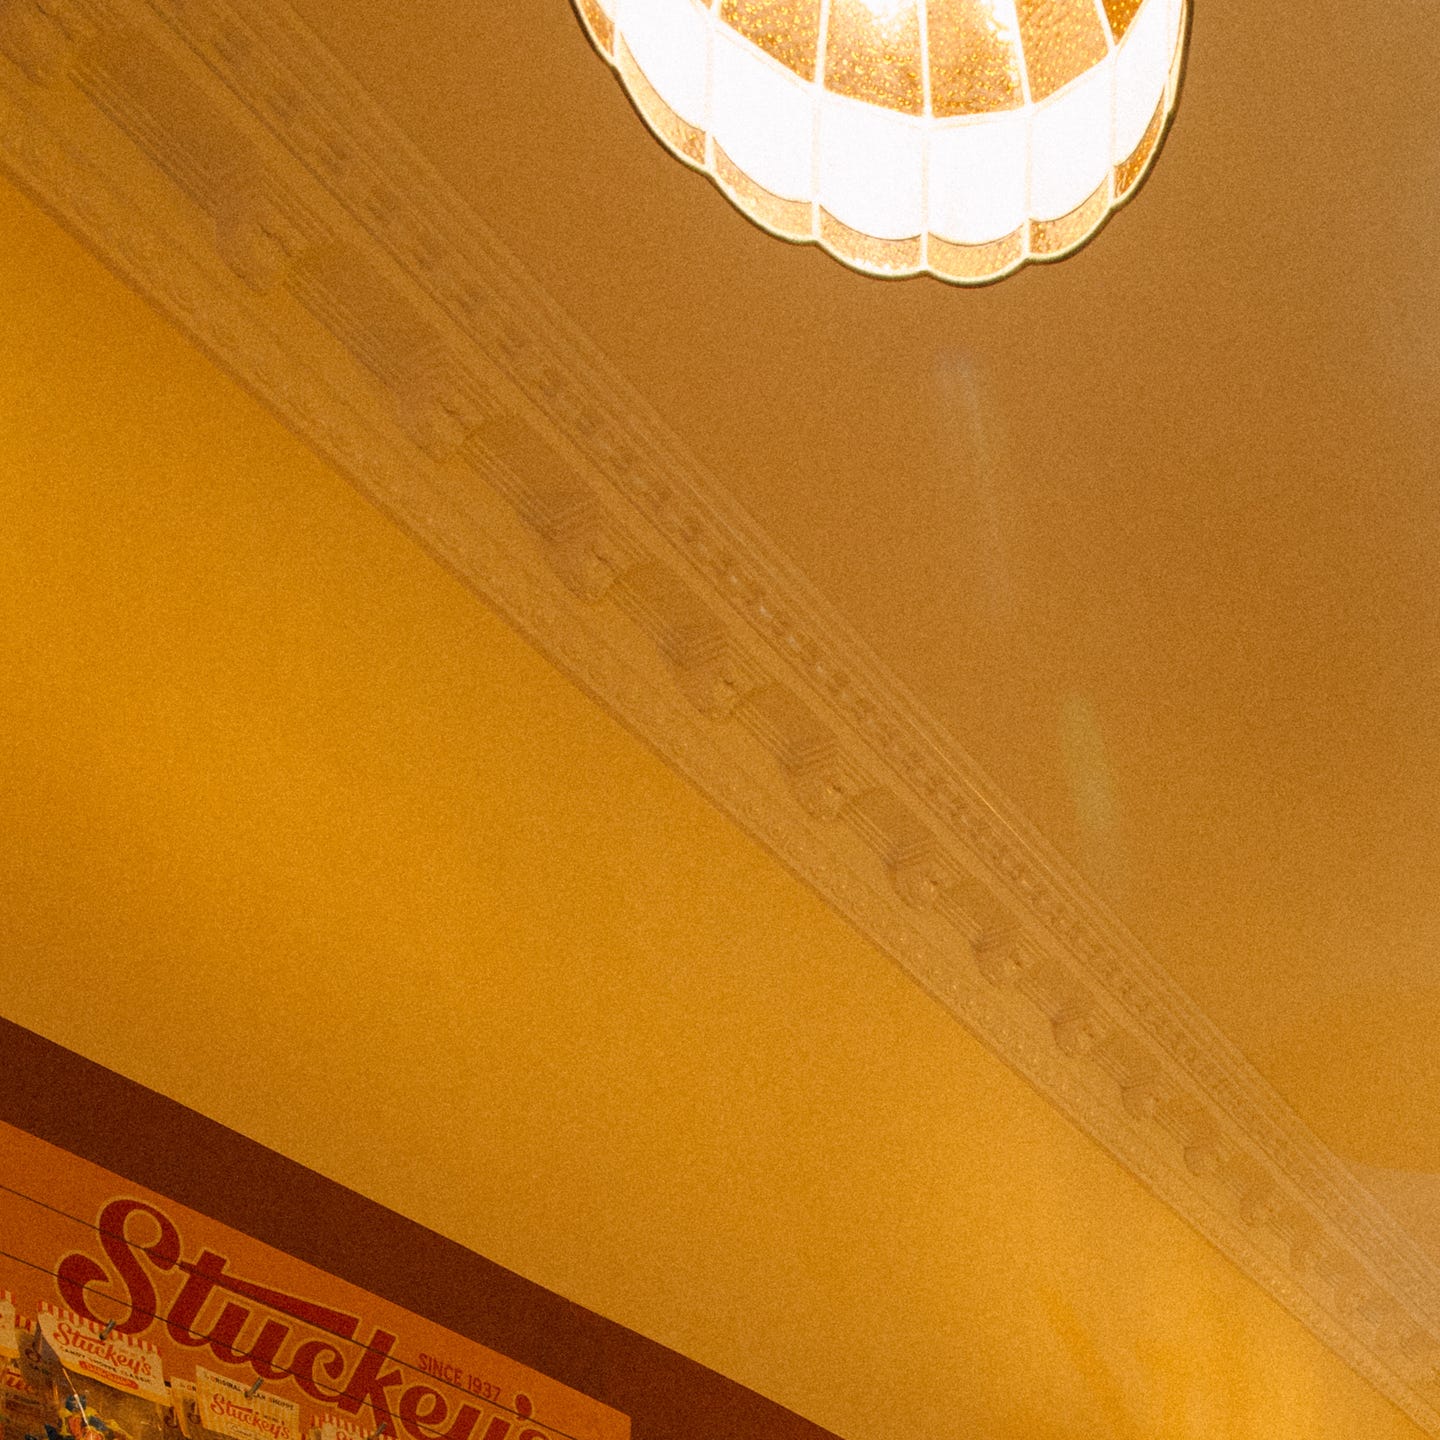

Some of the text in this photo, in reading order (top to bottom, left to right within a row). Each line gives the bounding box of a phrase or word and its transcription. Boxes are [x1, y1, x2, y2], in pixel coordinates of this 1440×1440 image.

[53, 1322, 152, 1378] Stuckey's
[418, 1353, 503, 1401] SINCE 1937
[210, 1393, 290, 1440] Stuckey's
